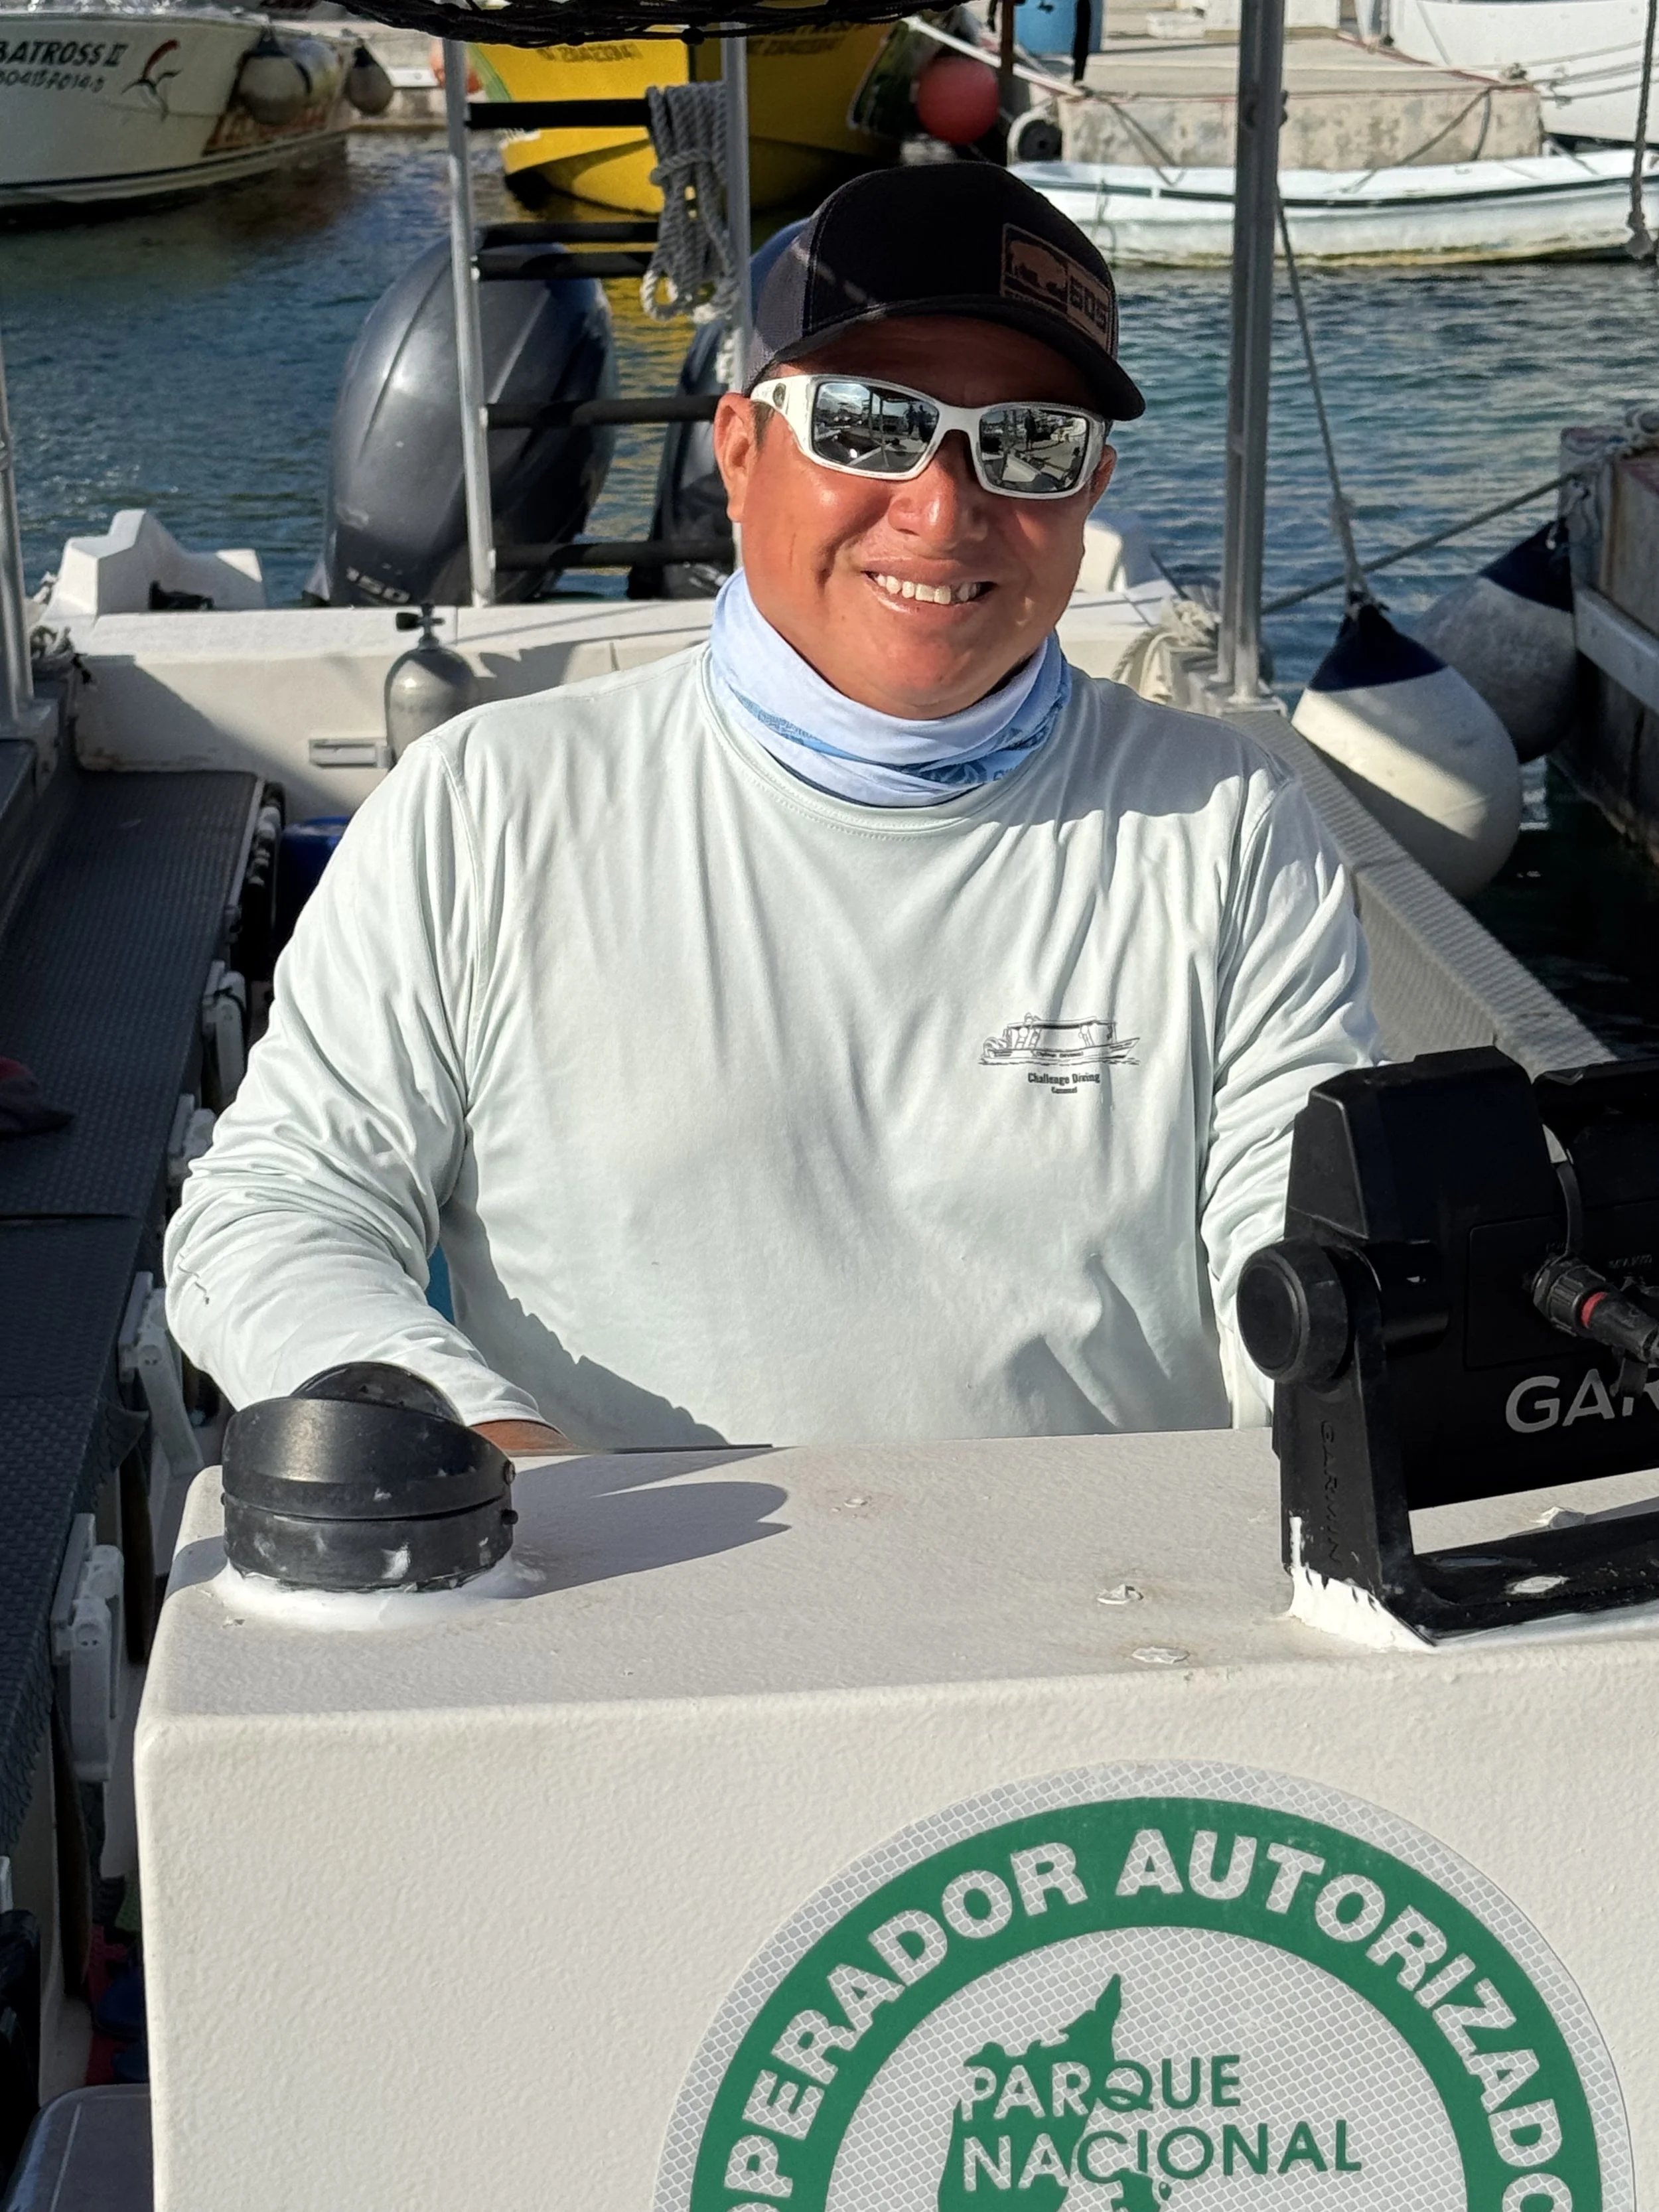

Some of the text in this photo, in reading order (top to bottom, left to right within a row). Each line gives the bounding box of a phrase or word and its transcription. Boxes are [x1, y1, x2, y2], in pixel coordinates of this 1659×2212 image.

[1028, 1072, 1070, 1086] Challenge
[722, 1826, 1573, 2212] PERADOR AUTORIZADO
[963, 2056, 1242, 2122] PARQUE
[962, 2122, 1362, 2193] NACIONAL
